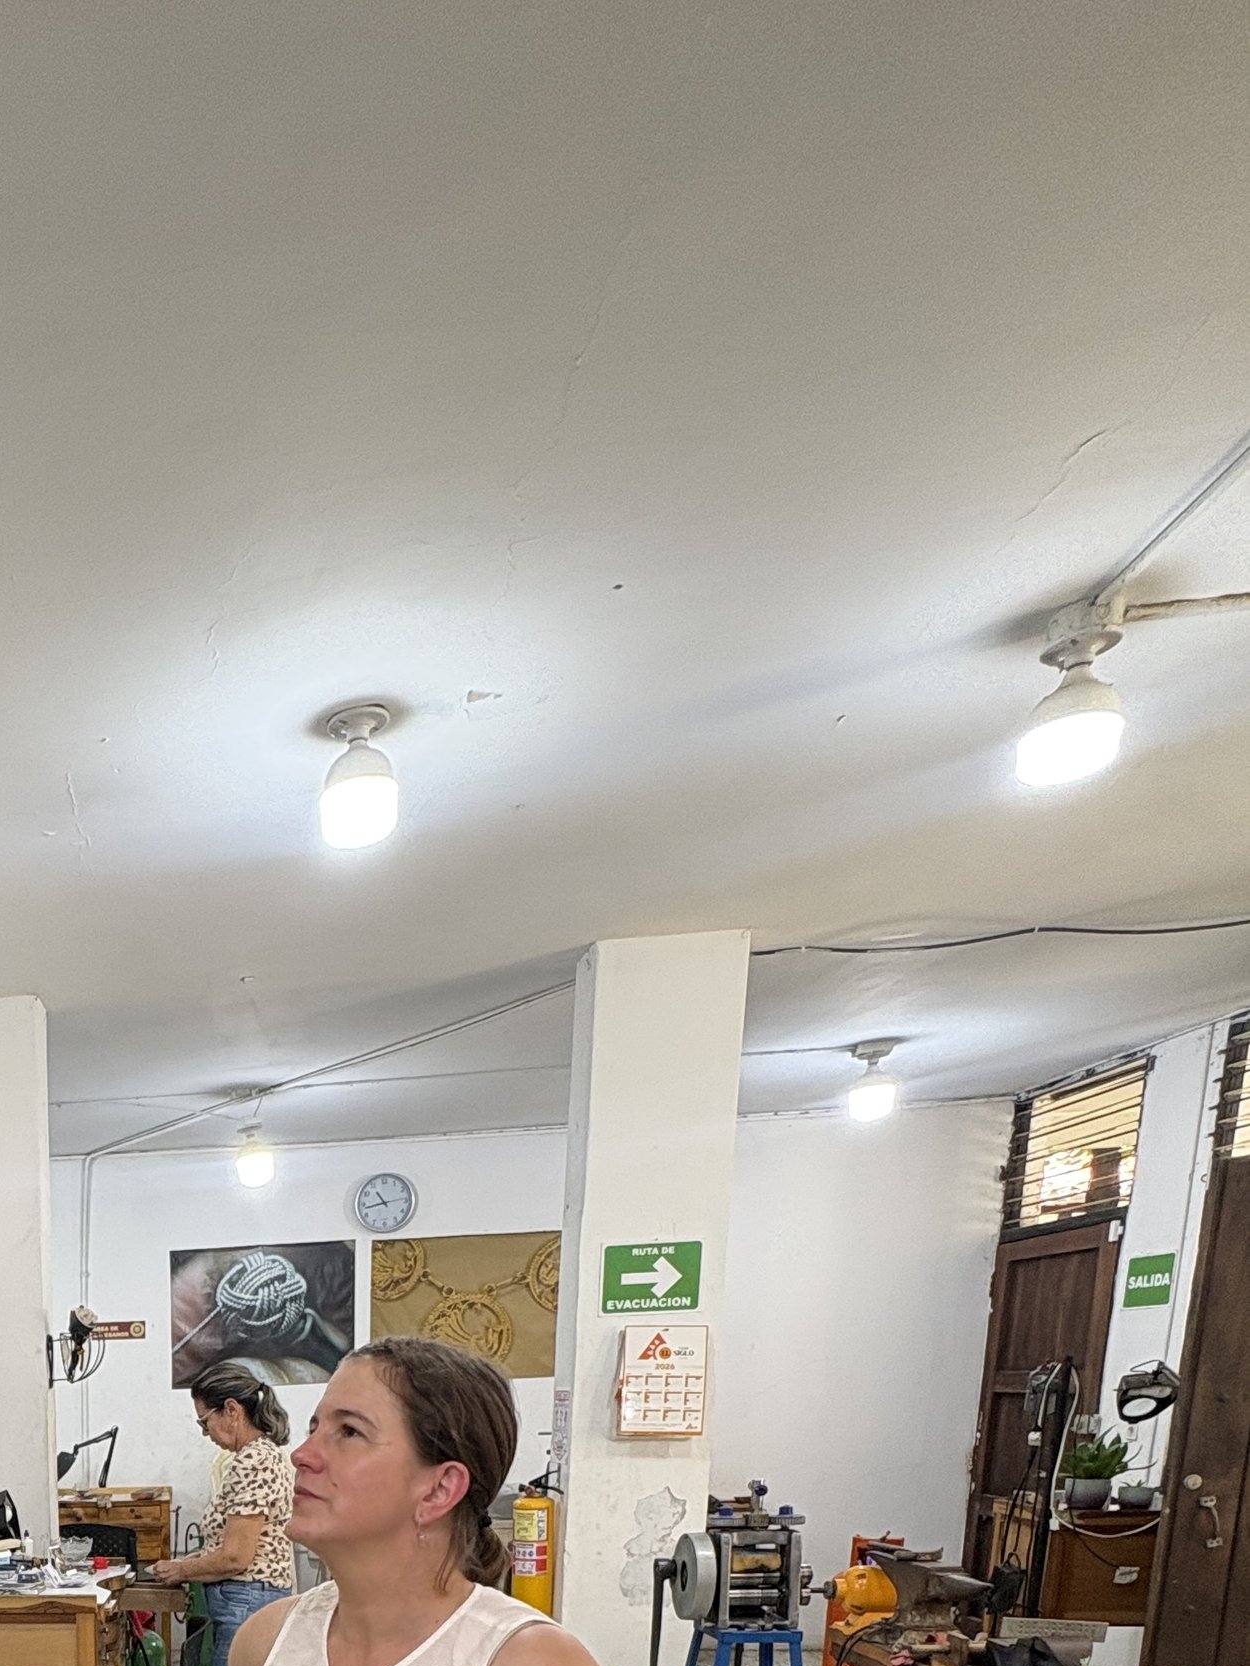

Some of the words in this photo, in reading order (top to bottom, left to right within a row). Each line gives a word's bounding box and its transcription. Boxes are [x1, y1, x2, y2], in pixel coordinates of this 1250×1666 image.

[632, 1247, 660, 1256] RUTA
[661, 1246, 675, 1254] DE
[1128, 1272, 1170, 1289] SALIDA
[606, 1297, 691, 1310] EVACUACION
